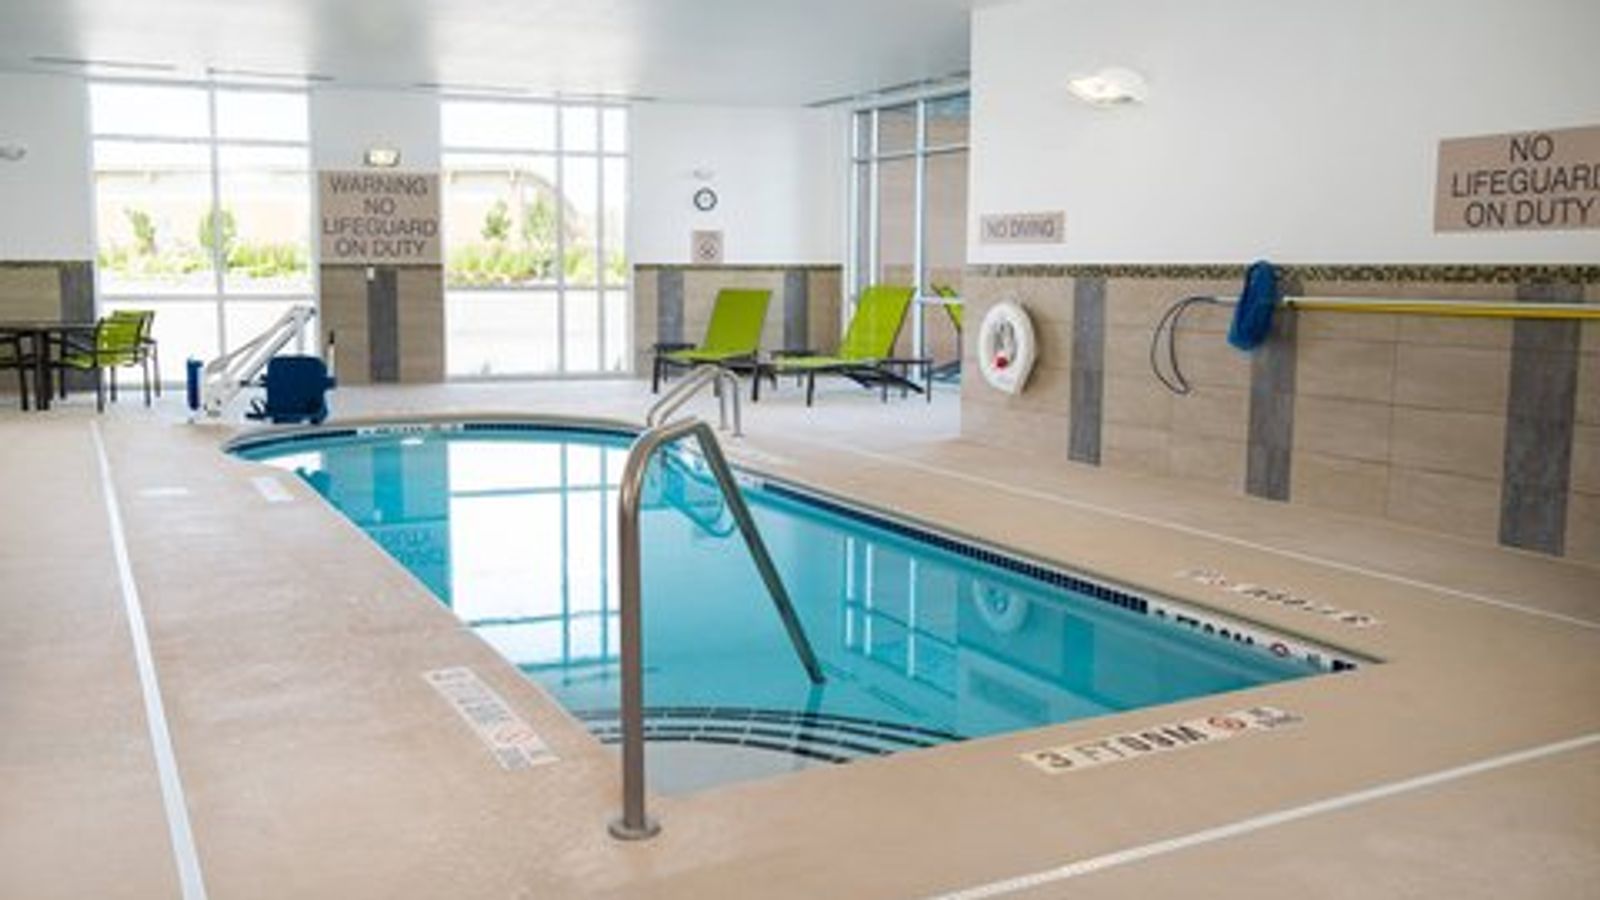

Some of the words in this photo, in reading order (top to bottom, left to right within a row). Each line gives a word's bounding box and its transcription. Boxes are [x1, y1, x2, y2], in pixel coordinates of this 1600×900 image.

[1510, 134, 1554, 162] NO
[330, 175, 428, 195] WARNING
[364, 197, 396, 214] NO
[1465, 200, 1507, 228] ON
[1516, 197, 1594, 226] DUTY
[322, 216, 438, 237] LIFEGUARD
[986, 219, 1008, 238] NO
[1009, 218, 1055, 237] DIVING
[334, 237, 367, 257] ON
[373, 239, 426, 257] DUTY
[1037, 752, 1072, 768] 3
[1075, 740, 1125, 760] FT
